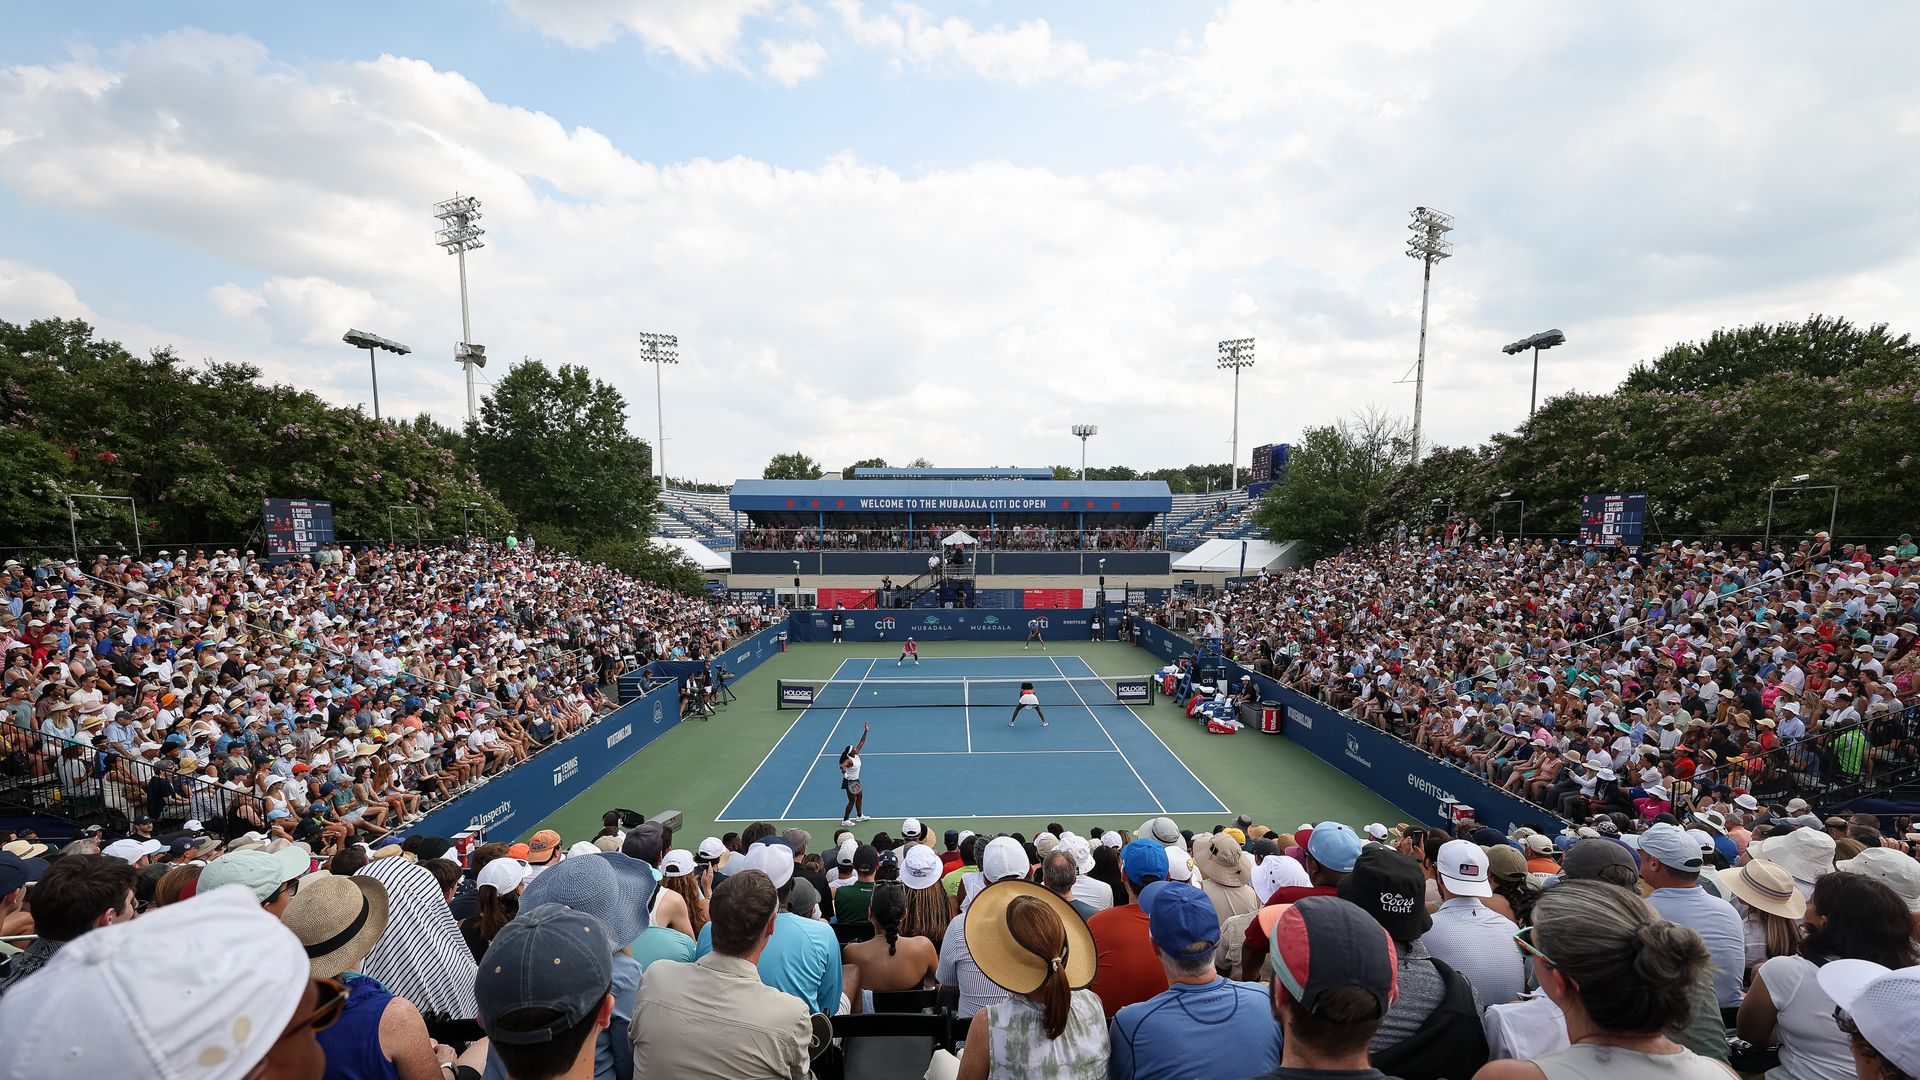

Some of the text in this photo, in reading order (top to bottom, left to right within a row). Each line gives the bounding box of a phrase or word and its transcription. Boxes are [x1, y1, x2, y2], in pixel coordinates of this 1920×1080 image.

[860, 499, 1046, 509] WELCOME TO THE MUBADALA CITI DC OPEN
[875, 618, 896, 630] citi
[561, 756, 579, 775] TENNIS
[480, 800, 512, 825] Insperity
[1380, 892, 1414, 906] Coors
